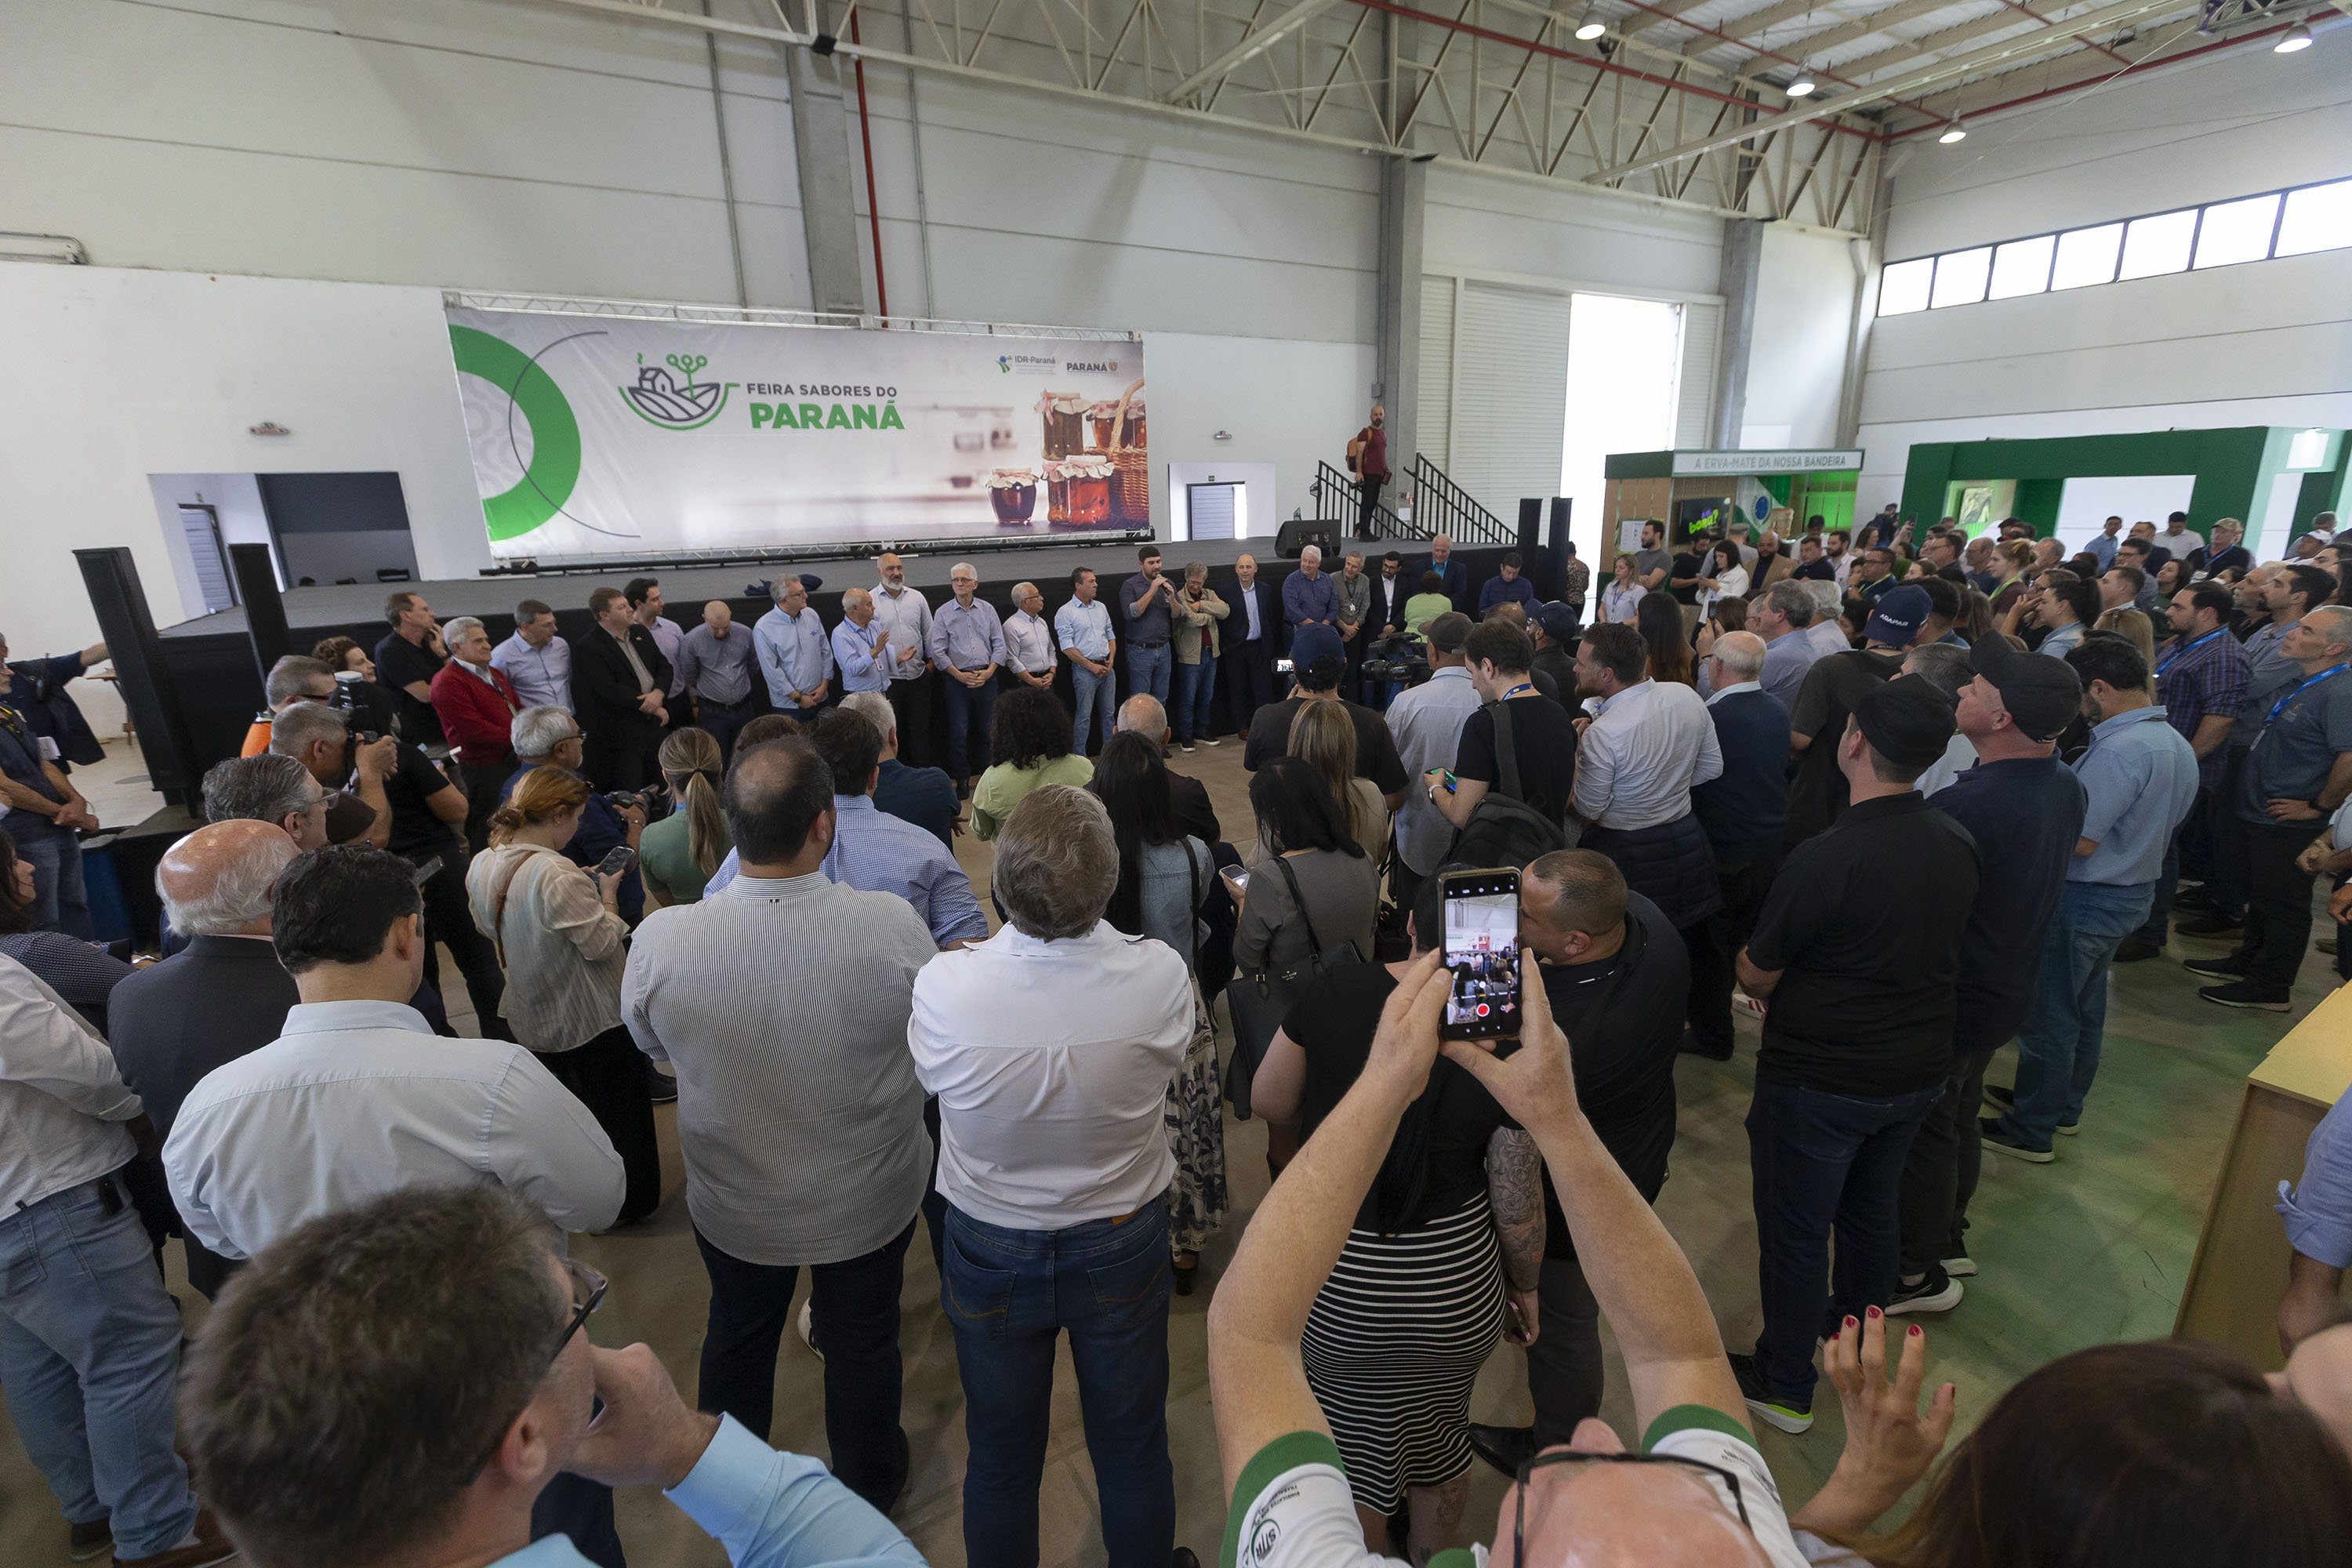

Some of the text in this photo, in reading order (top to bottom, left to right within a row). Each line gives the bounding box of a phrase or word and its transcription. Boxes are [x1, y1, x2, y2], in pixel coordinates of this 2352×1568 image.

[1014, 355, 1055, 365] IDR-Paraná
[1066, 361, 1108, 372] PARANÁ
[746, 383, 898, 397] FEIRA SABORES DO
[750, 399, 906, 430] PARANÁ
[1694, 455, 1846, 469] A ERVA-MATE DA NOSSA BANDEIRA
[1879, 613, 1909, 626] ADAPAR
